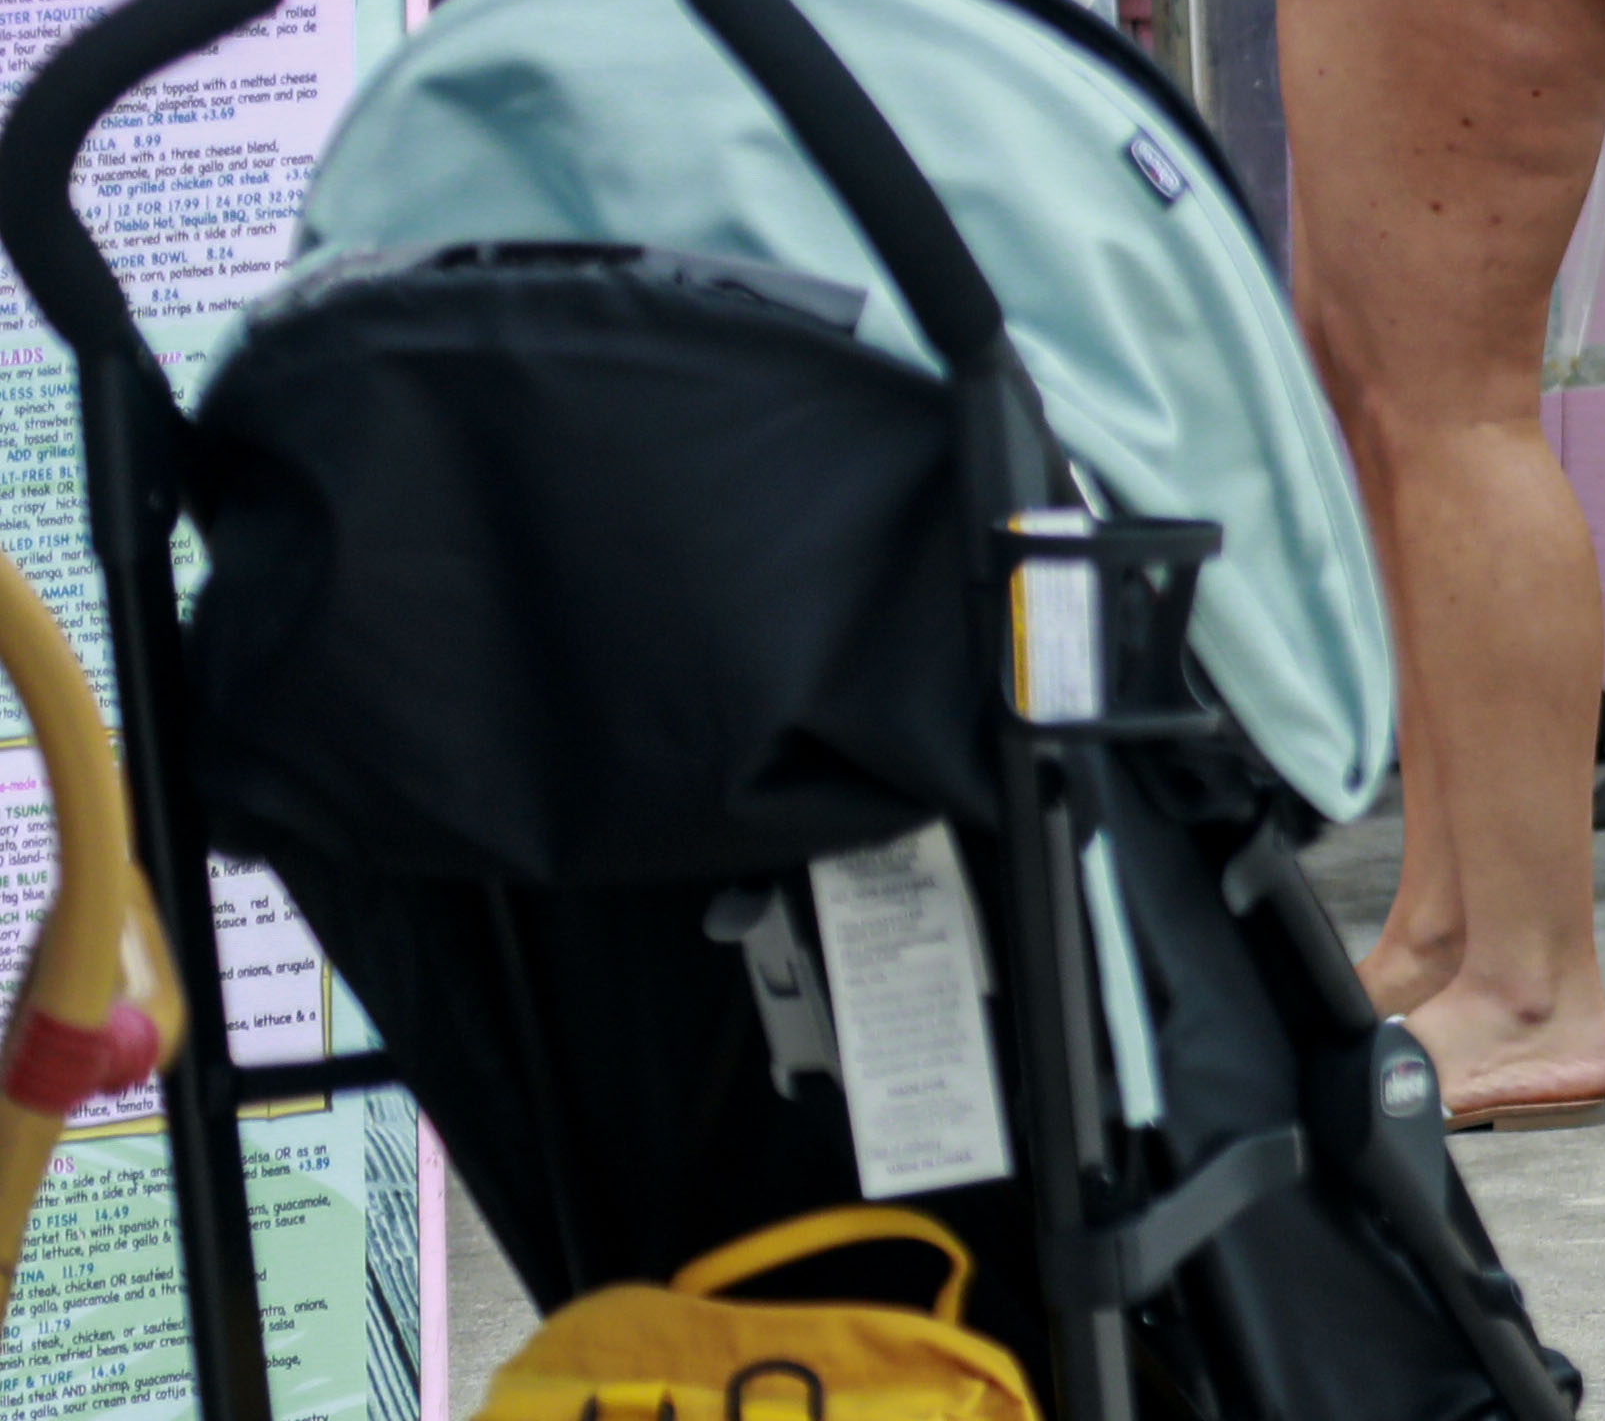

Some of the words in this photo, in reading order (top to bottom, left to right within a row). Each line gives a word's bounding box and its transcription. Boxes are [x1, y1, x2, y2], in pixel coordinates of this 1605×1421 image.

[162, 81, 199, 98] topped
[203, 78, 227, 92] with
[240, 73, 276, 89] melted
[280, 72, 317, 85] cheese
[101, 116, 143, 130] chicken
[168, 110, 198, 124] steak
[133, 134, 161, 149] 8.99
[47, 1212, 77, 1228] FISH
[95, 1206, 129, 1223] 14.49
[40, 1370, 73, 1387] TURF
[91, 1363, 126, 1380] 14.49
